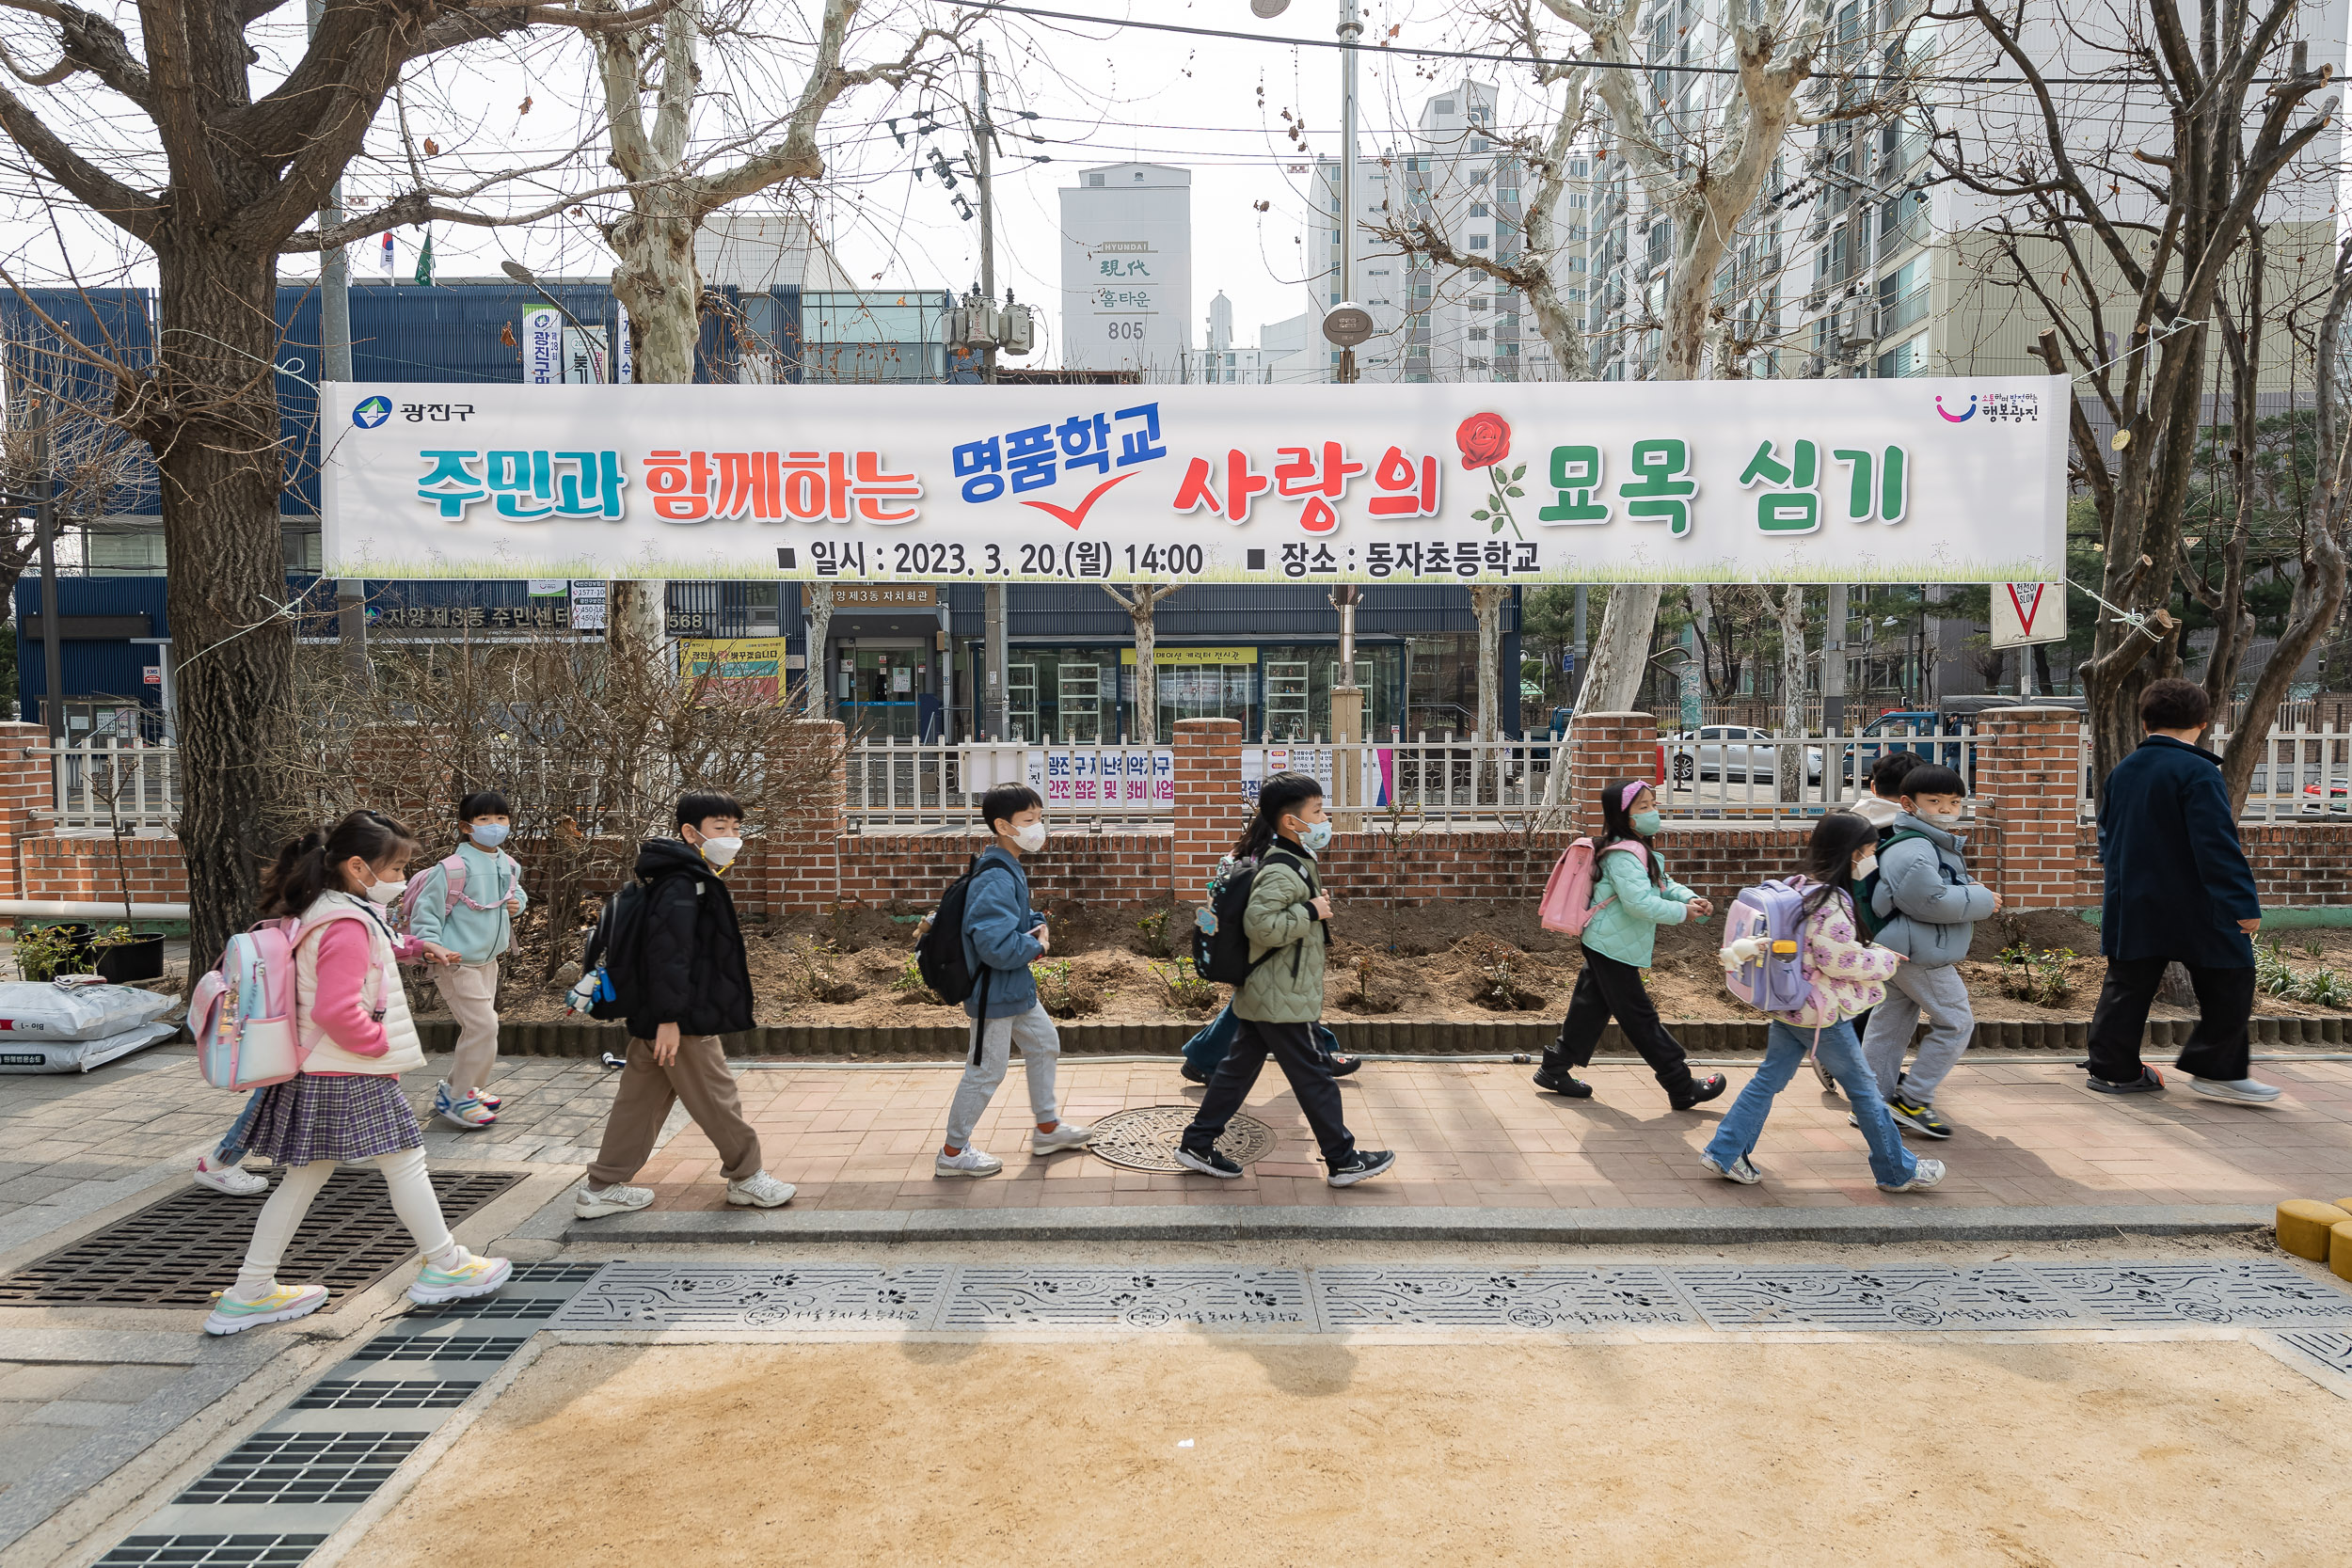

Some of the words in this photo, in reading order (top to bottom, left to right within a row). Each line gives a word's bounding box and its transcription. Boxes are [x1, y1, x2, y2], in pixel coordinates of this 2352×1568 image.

[1104, 243, 1147, 251] HYUNDAI
[1100, 259, 1151, 277] 現代
[1100, 291, 1151, 308] 홈타운
[1108, 322, 1144, 340] 805
[1981, 393, 2009, 405] 소통하며
[2010, 393, 2039, 404] 발전하는
[400, 403, 476, 423] 광진구
[1981, 404, 2039, 423] 행복광진
[418, 449, 626, 521] 주민과
[643, 449, 924, 525] 함께하는
[952, 402, 1167, 504] 명품학교
[1172, 440, 1441, 534] 사랑의
[1538, 437, 1699, 539] 묘목
[1739, 437, 1910, 535] 심기
[810, 541, 866, 576] 일시
[1124, 543, 1204, 575] 14:00
[1280, 541, 1336, 577] 장소
[1365, 540, 1541, 578] 동자초등학교
[849, 591, 880, 602] 제3동
[882, 591, 929, 602] 자치회관
[2019, 594, 2035, 604] SLOW
[389, 608, 426, 627] 자양
[431, 607, 485, 627] 제3동
[491, 607, 573, 626] 주민센터
[669, 614, 704, 628] 568
[731, 650, 778, 660] 바꾸겠습니다
[1049, 756, 1087, 776] 광진구
[1049, 780, 1097, 800] 안전점검
[1104, 780, 1118, 800] 및
[1097, 1146, 1187, 1169] OVERNMENT
